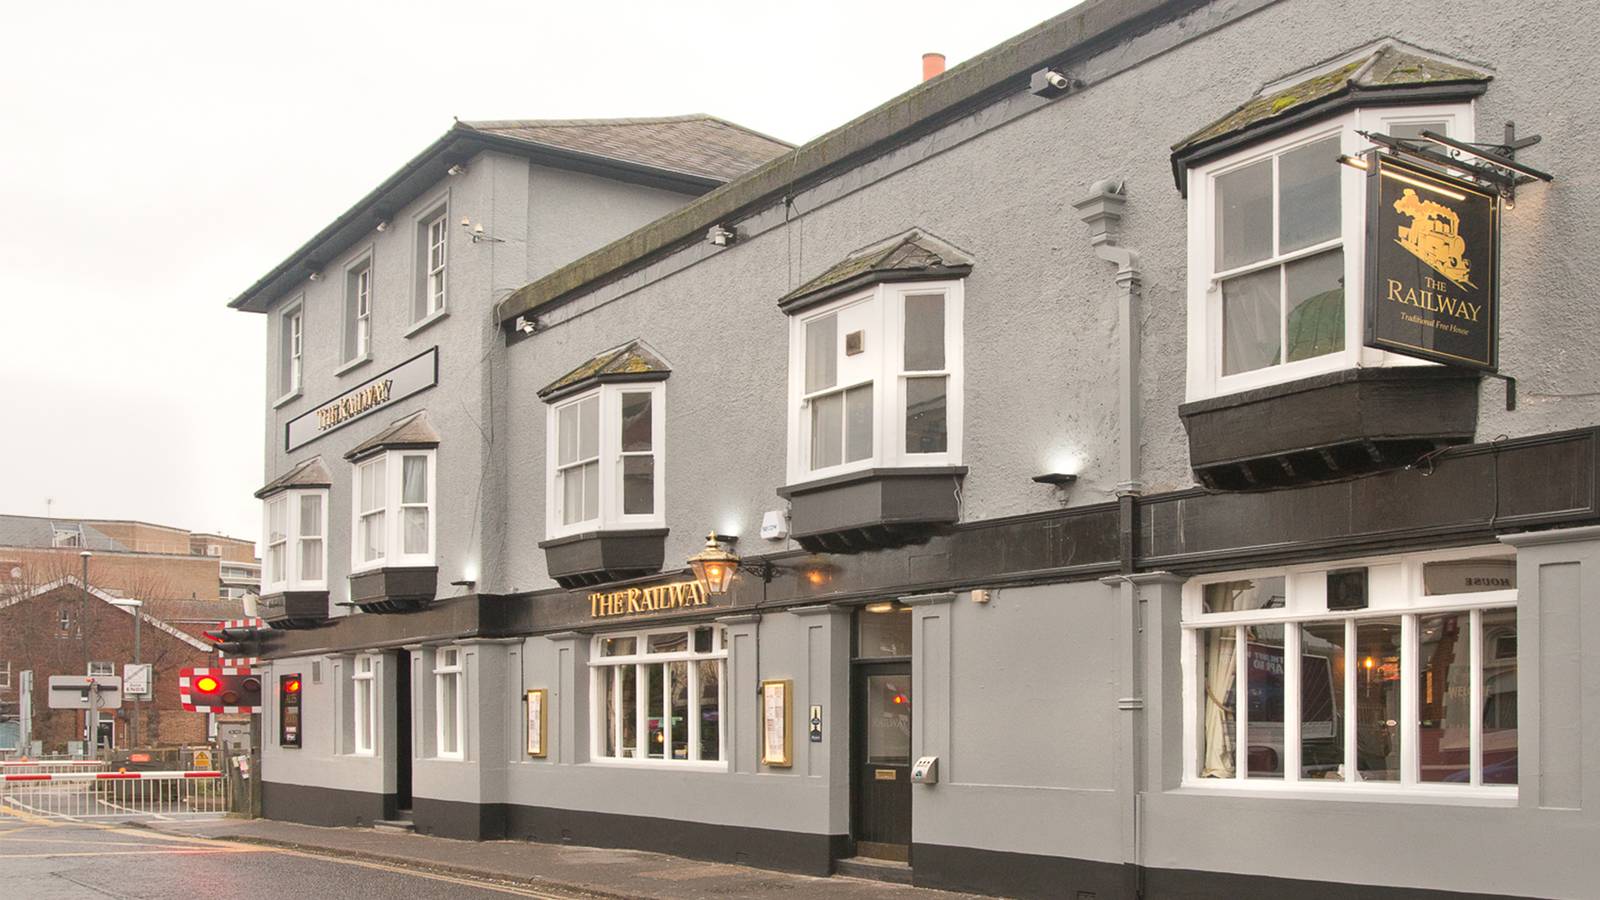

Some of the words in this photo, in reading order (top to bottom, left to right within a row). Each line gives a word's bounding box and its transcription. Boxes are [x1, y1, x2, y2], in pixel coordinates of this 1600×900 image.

[1424, 276, 1447, 293] THE
[1386, 278, 1482, 322] RAILWAY
[1400, 311, 1435, 328] Traditional
[1435, 319, 1449, 331] Free
[1449, 324, 1470, 336] House
[316, 404, 340, 431] THE
[588, 591, 624, 618] THE
[626, 581, 706, 612] RAILWAY
